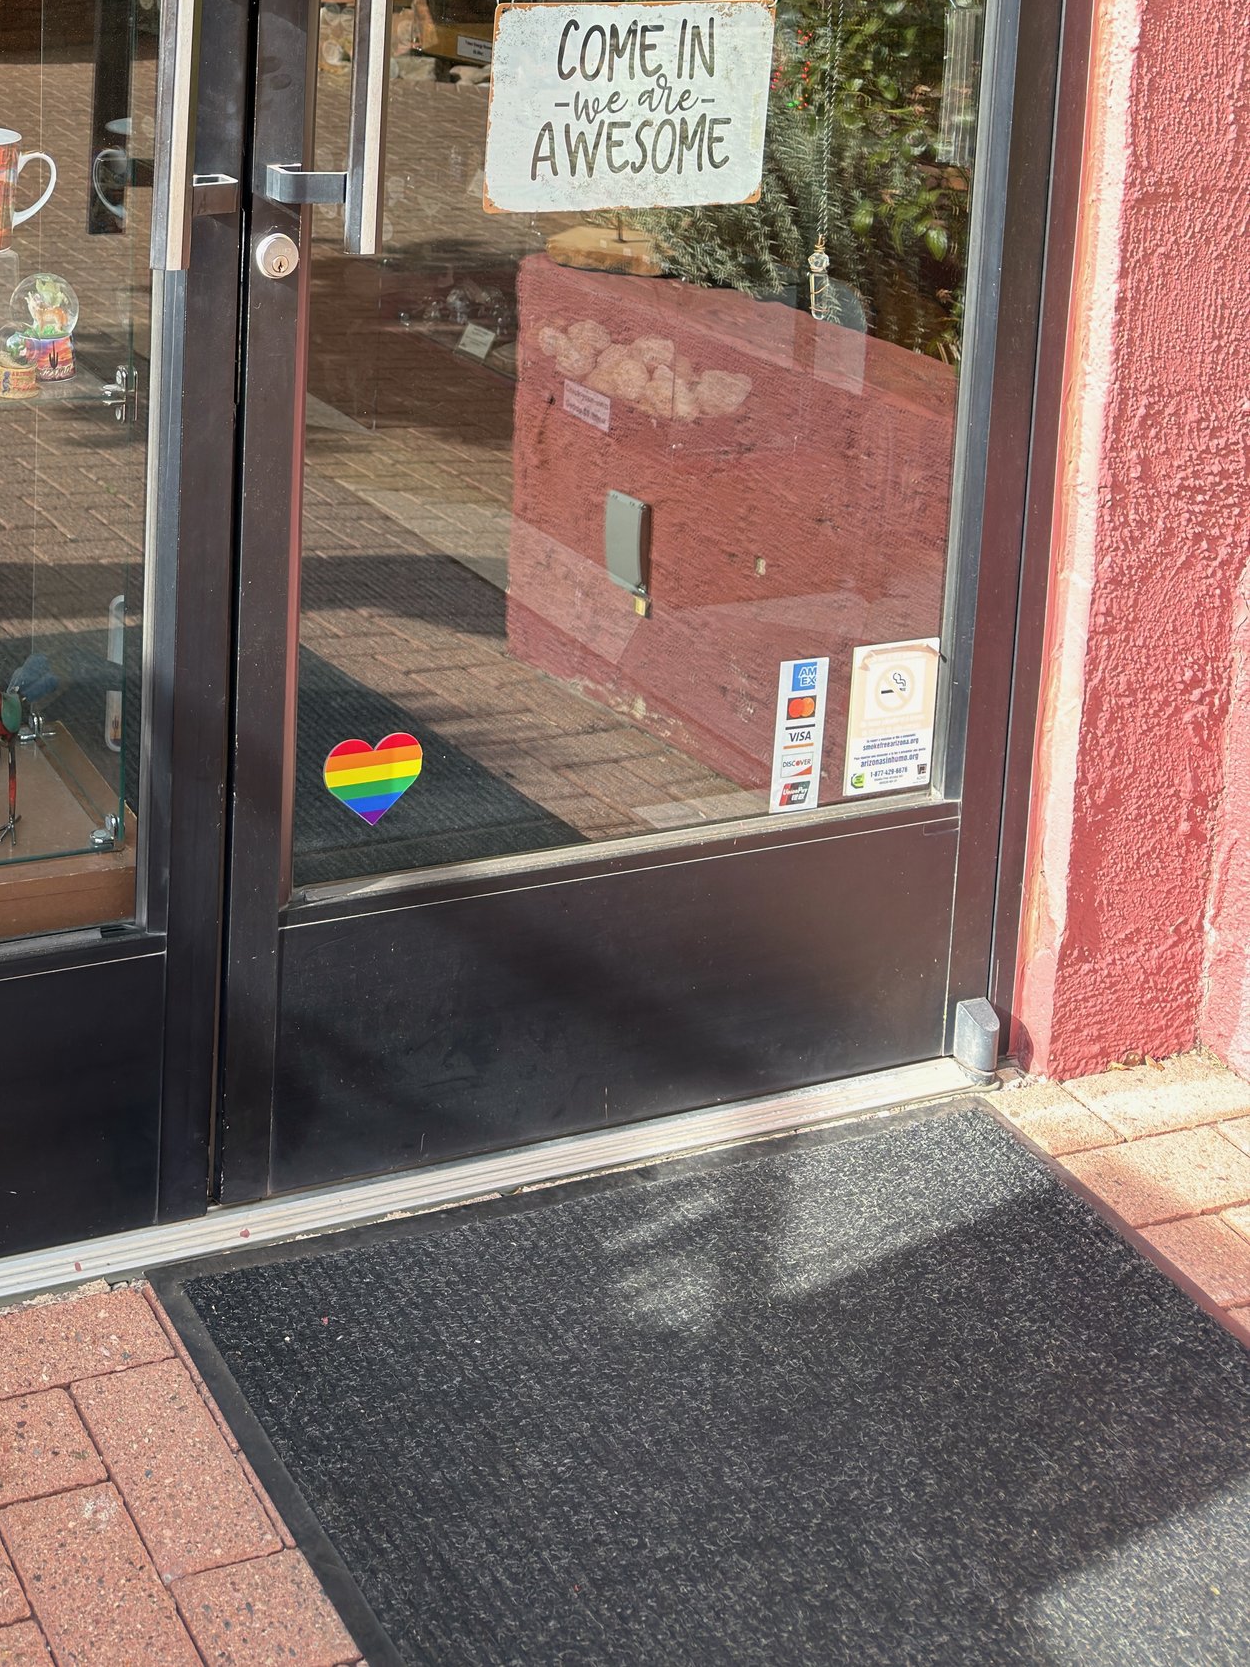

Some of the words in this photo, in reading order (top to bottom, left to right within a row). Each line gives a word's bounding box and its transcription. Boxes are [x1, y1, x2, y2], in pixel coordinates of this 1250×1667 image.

[557, 19, 664, 82] COME
[677, 17, 715, 79] IN
[531, 113, 732, 181] AWESOME
[799, 666, 817, 677] AM
[801, 677, 816, 686] EX
[789, 731, 811, 742] VISA
[863, 738, 919, 751] smokefreearizona.org
[782, 758, 811, 768] DISCOVER
[860, 753, 919, 767] arizonasinhumo.org
[783, 786, 807, 795] UnionPay
